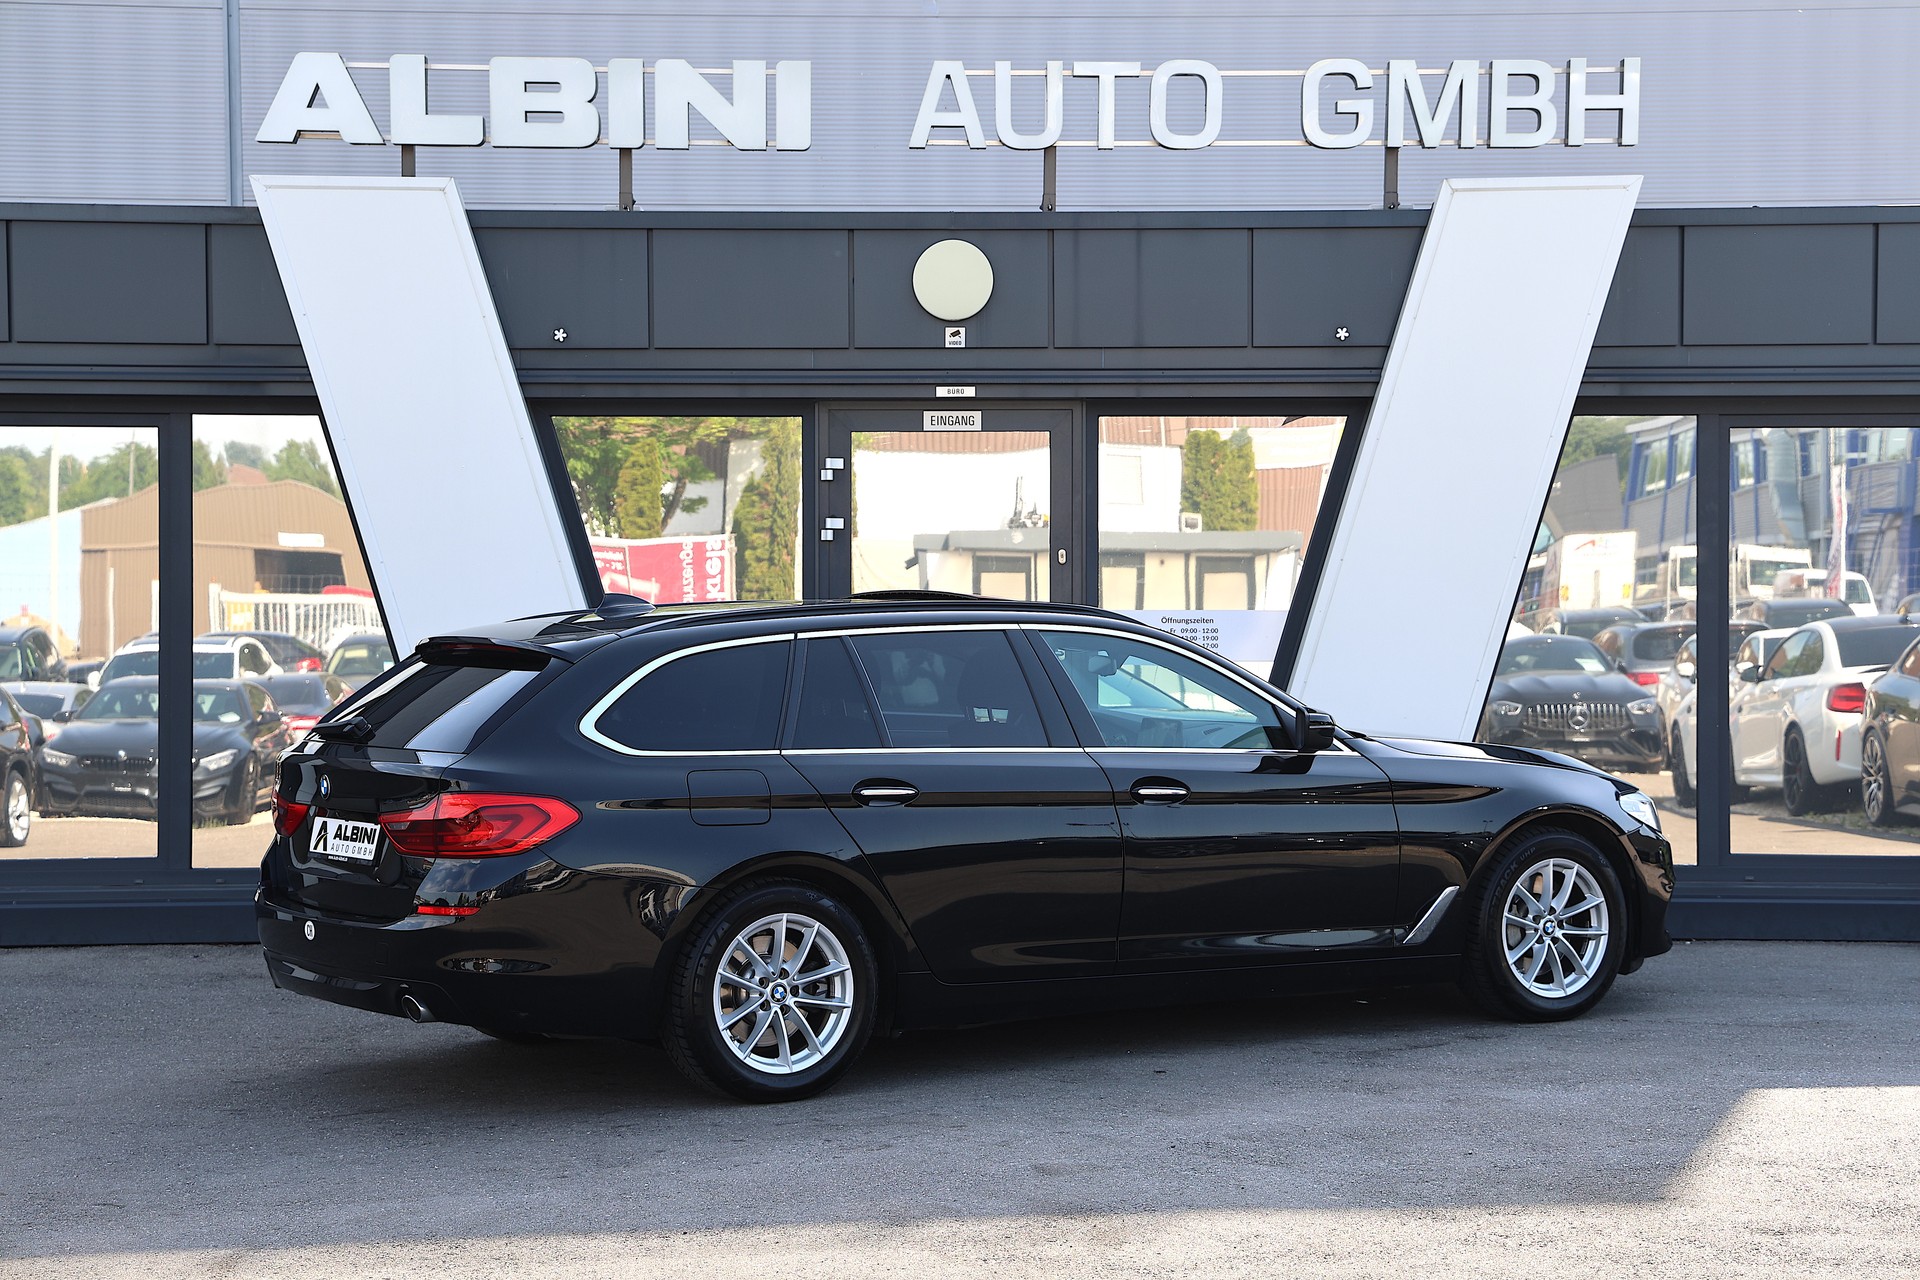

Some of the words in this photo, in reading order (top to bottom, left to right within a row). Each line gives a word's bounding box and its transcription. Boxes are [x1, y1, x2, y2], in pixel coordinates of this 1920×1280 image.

[255, 52, 812, 152] ALBINI
[909, 58, 1223, 150] AUTO
[1301, 57, 1641, 150] GMBH
[930, 415, 975, 426] EINGANG
[1161, 616, 1214, 625] Öffnungszeiten
[333, 824, 377, 845] ALBINI
[330, 843, 349, 854] AUTO
[351, 845, 374, 857] GMBH
